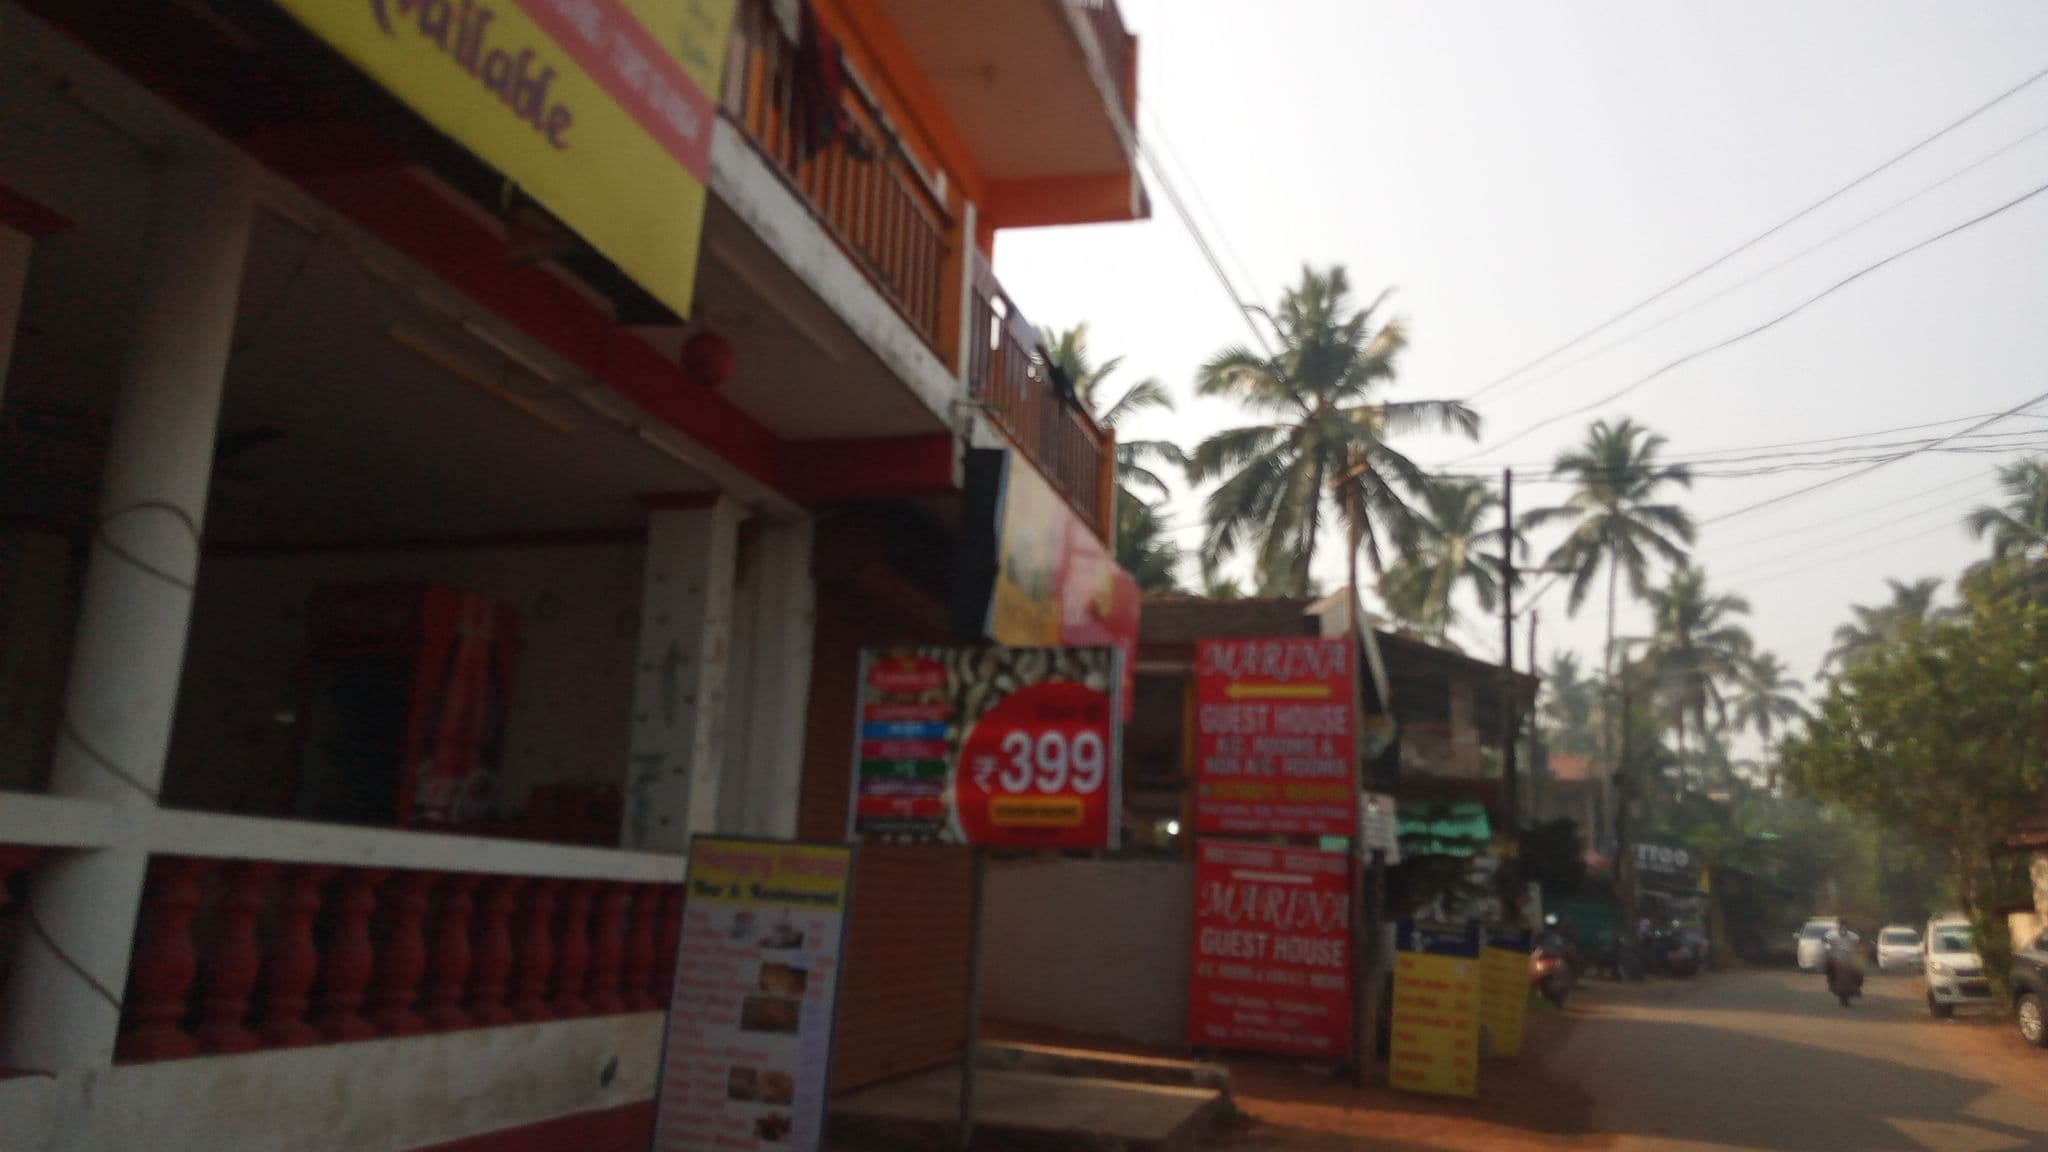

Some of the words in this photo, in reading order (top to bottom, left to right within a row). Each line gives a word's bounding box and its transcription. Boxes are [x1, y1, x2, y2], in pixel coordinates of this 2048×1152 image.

[371, 0, 573, 151] ailable
[1200, 704, 1269, 735] GUEST
[1274, 705, 1348, 736] HOUSE
[1200, 879, 1350, 933] MARINA
[1200, 926, 1268, 960] GUEST
[1273, 935, 1345, 968] HOUSE
